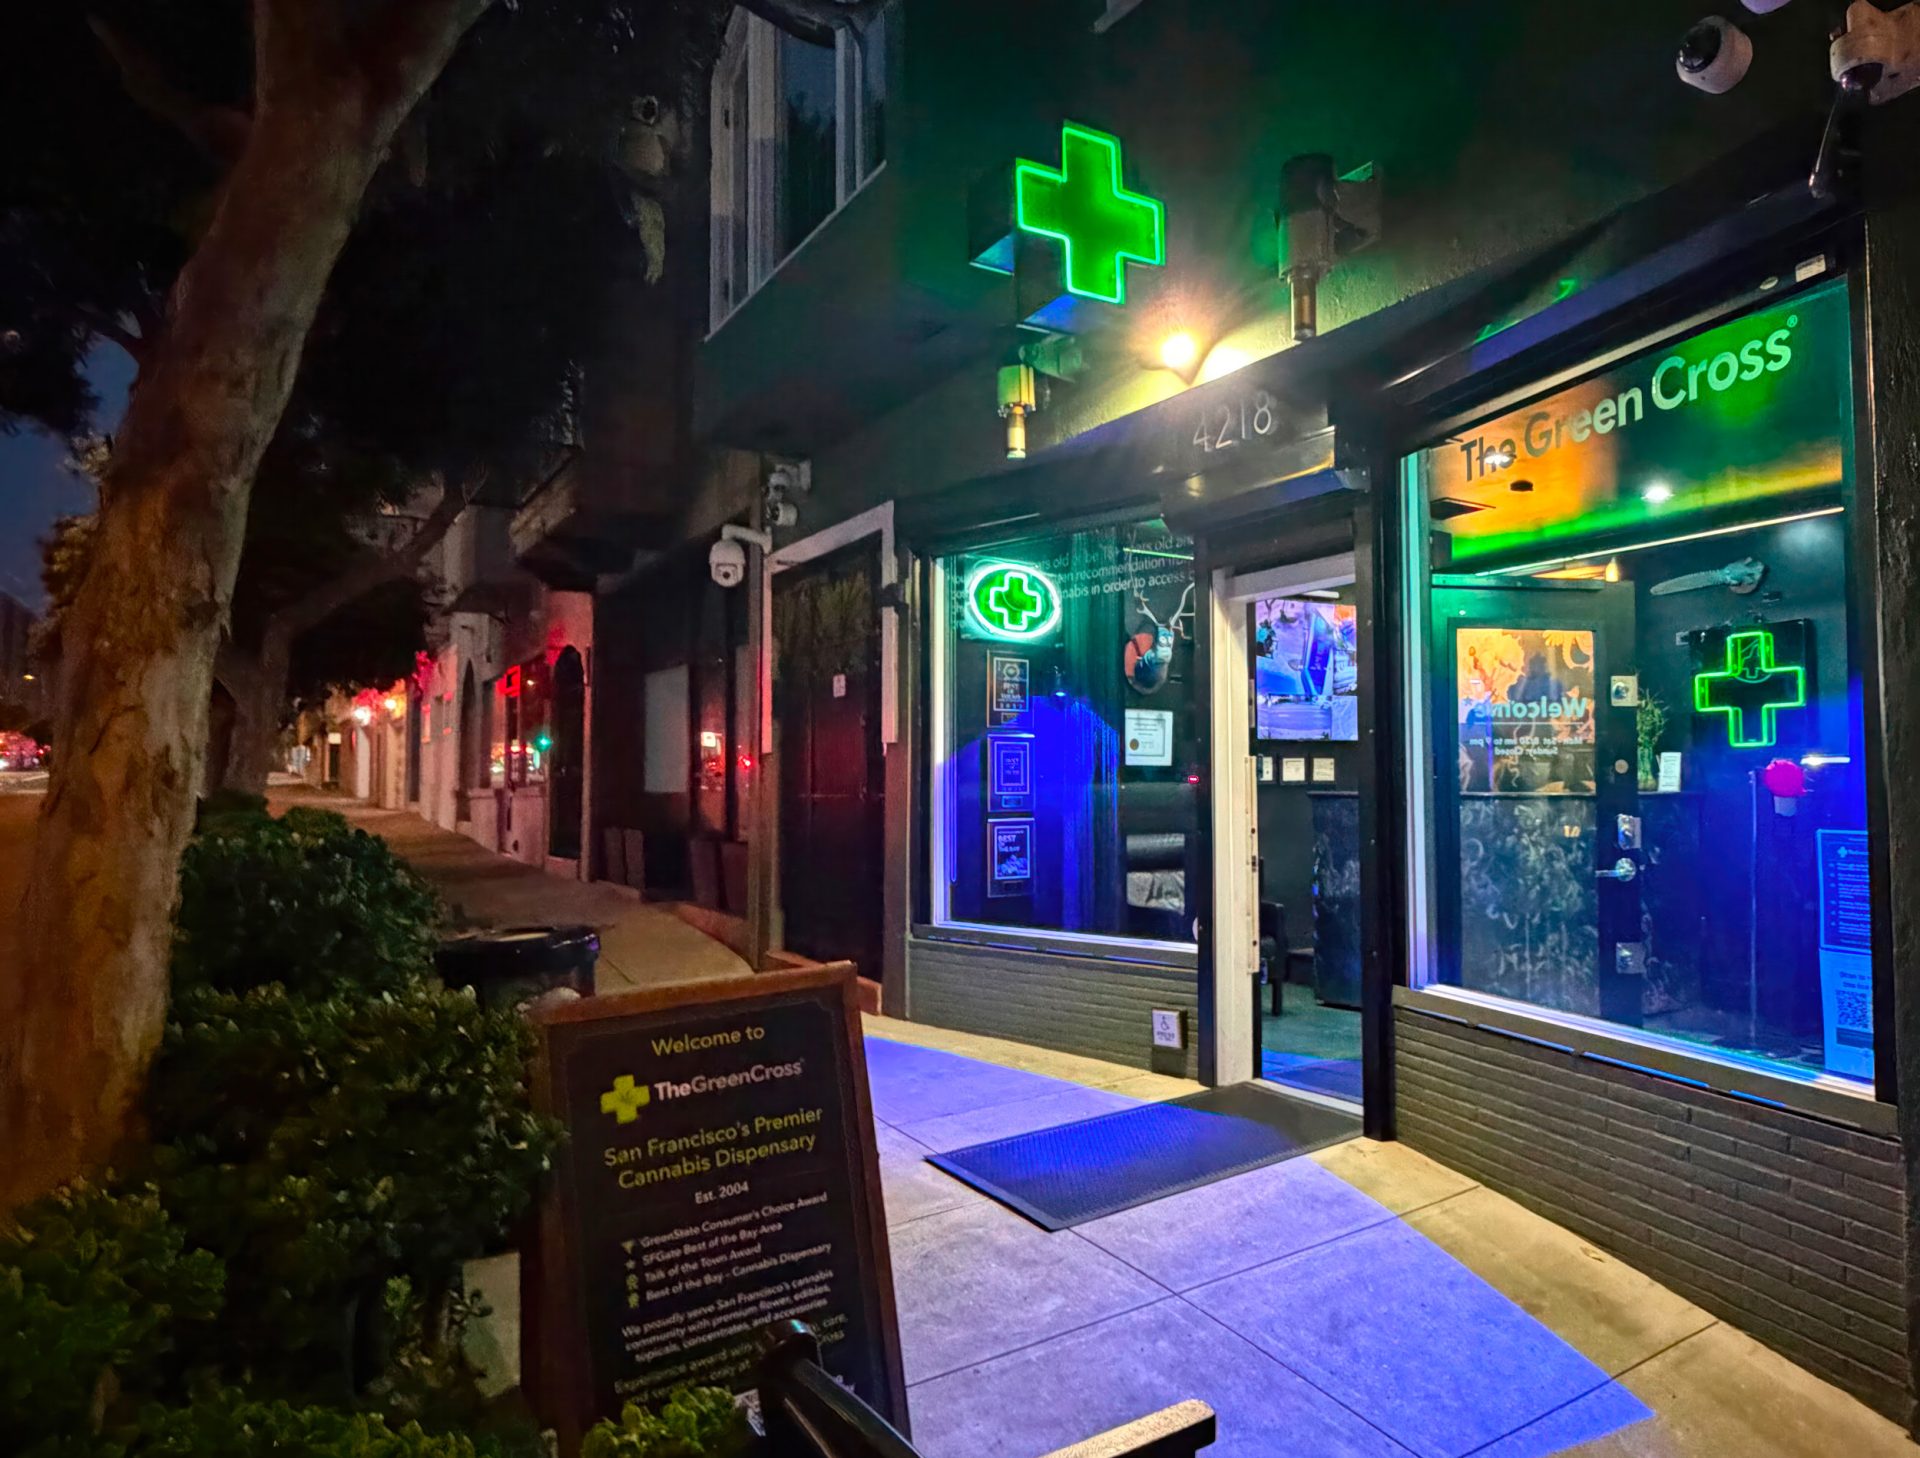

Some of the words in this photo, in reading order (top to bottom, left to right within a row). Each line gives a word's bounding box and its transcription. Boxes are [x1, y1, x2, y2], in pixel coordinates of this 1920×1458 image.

[1193, 389, 1273, 452] 4218
[1461, 433, 1517, 482] The
[1524, 386, 1643, 458] Green
[1154, 536, 1173, 550] old
[1075, 557, 1165, 581] recommendation
[1091, 583, 1101, 595] in
[1103, 577, 1133, 594] order
[1133, 576, 1146, 589] to
[1148, 571, 1186, 587] access
[651, 1034, 741, 1057] Welcome
[747, 1025, 765, 1041] to
[604, 1147, 641, 1167] San
[647, 1122, 750, 1157] Francisco's
[754, 1108, 823, 1134] Premier
[618, 1155, 711, 1189] Cannabis
[715, 1133, 817, 1168] Dispensary
[695, 1190, 717, 1204] Est.
[718, 1181, 750, 1199] 2004
[640, 1226, 700, 1248] GreenState
[761, 1203, 796, 1217] Choice
[797, 1191, 828, 1208] Award
[642, 1248, 683, 1266] SFGate
[683, 1241, 707, 1255] Best
[708, 1235, 719, 1248] of
[720, 1233, 738, 1245] the
[739, 1228, 758, 1241] Bay
[759, 1221, 783, 1235] Area
[644, 1267, 666, 1283] Talk
[667, 1264, 680, 1277] of
[680, 1261, 699, 1274] the
[700, 1254, 728, 1268] Town
[729, 1242, 762, 1260] Award
[646, 1286, 670, 1301] Best
[671, 1281, 683, 1294] of
[684, 1278, 703, 1290] the
[703, 1272, 723, 1286] Bay
[732, 1257, 778, 1277] Cannabis
[778, 1243, 832, 1264] Dispensary
[621, 1325, 642, 1338] We
[642, 1312, 685, 1334] proudly
[686, 1303, 716, 1319] serve
[716, 1297, 737, 1311] San
[737, 1281, 790, 1303] Francisco's
[791, 1269, 834, 1289] cannabis
[752, 1311, 772, 1328] and
[625, 1327, 686, 1352] community
[687, 1318, 711, 1332] with
[711, 1305, 758, 1327] premium
